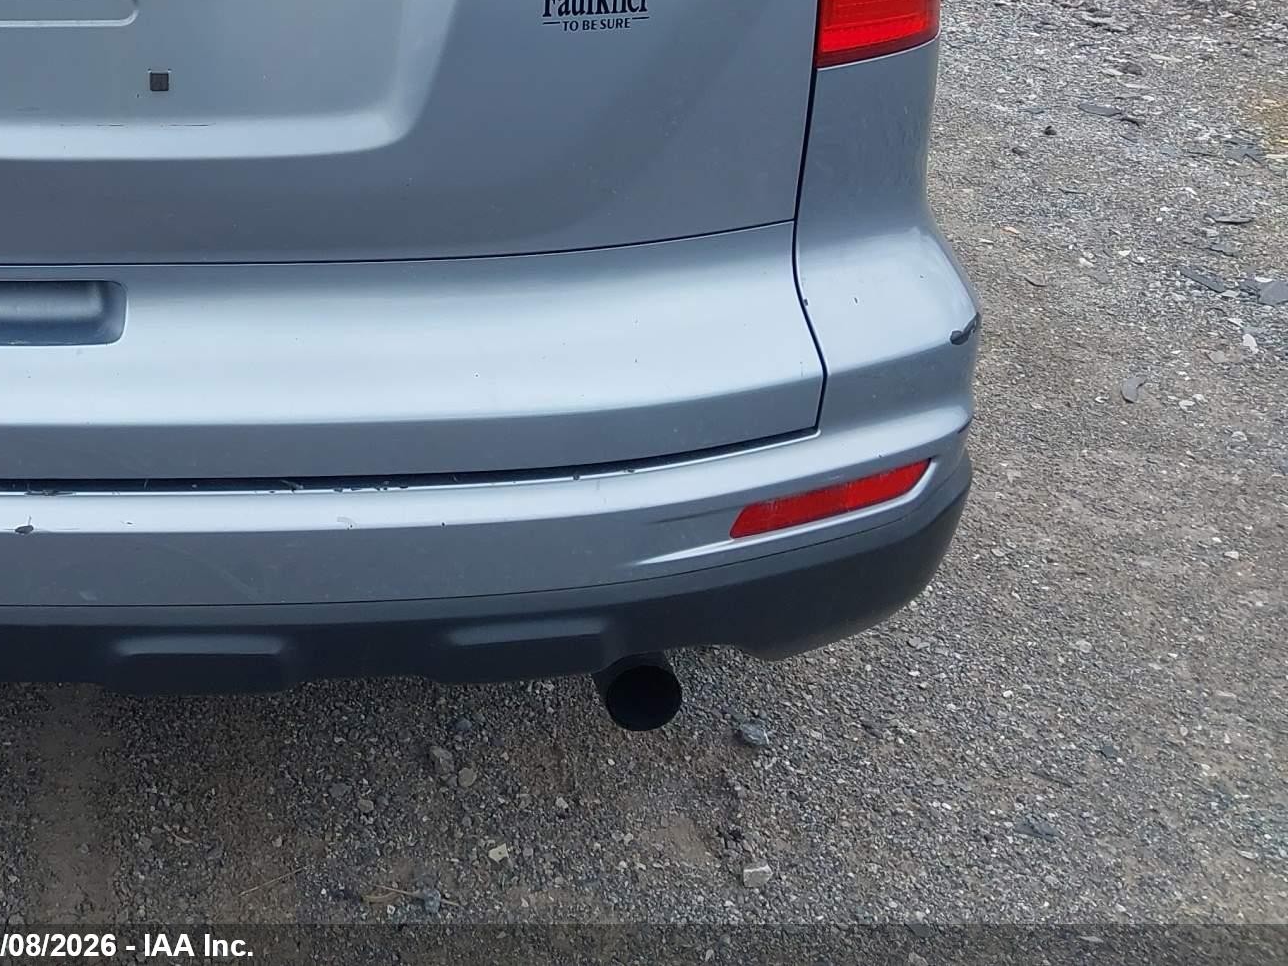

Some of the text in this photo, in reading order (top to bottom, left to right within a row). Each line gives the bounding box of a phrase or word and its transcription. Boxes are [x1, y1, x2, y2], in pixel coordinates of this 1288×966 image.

[562, 17, 631, 32] TO BE SURE
